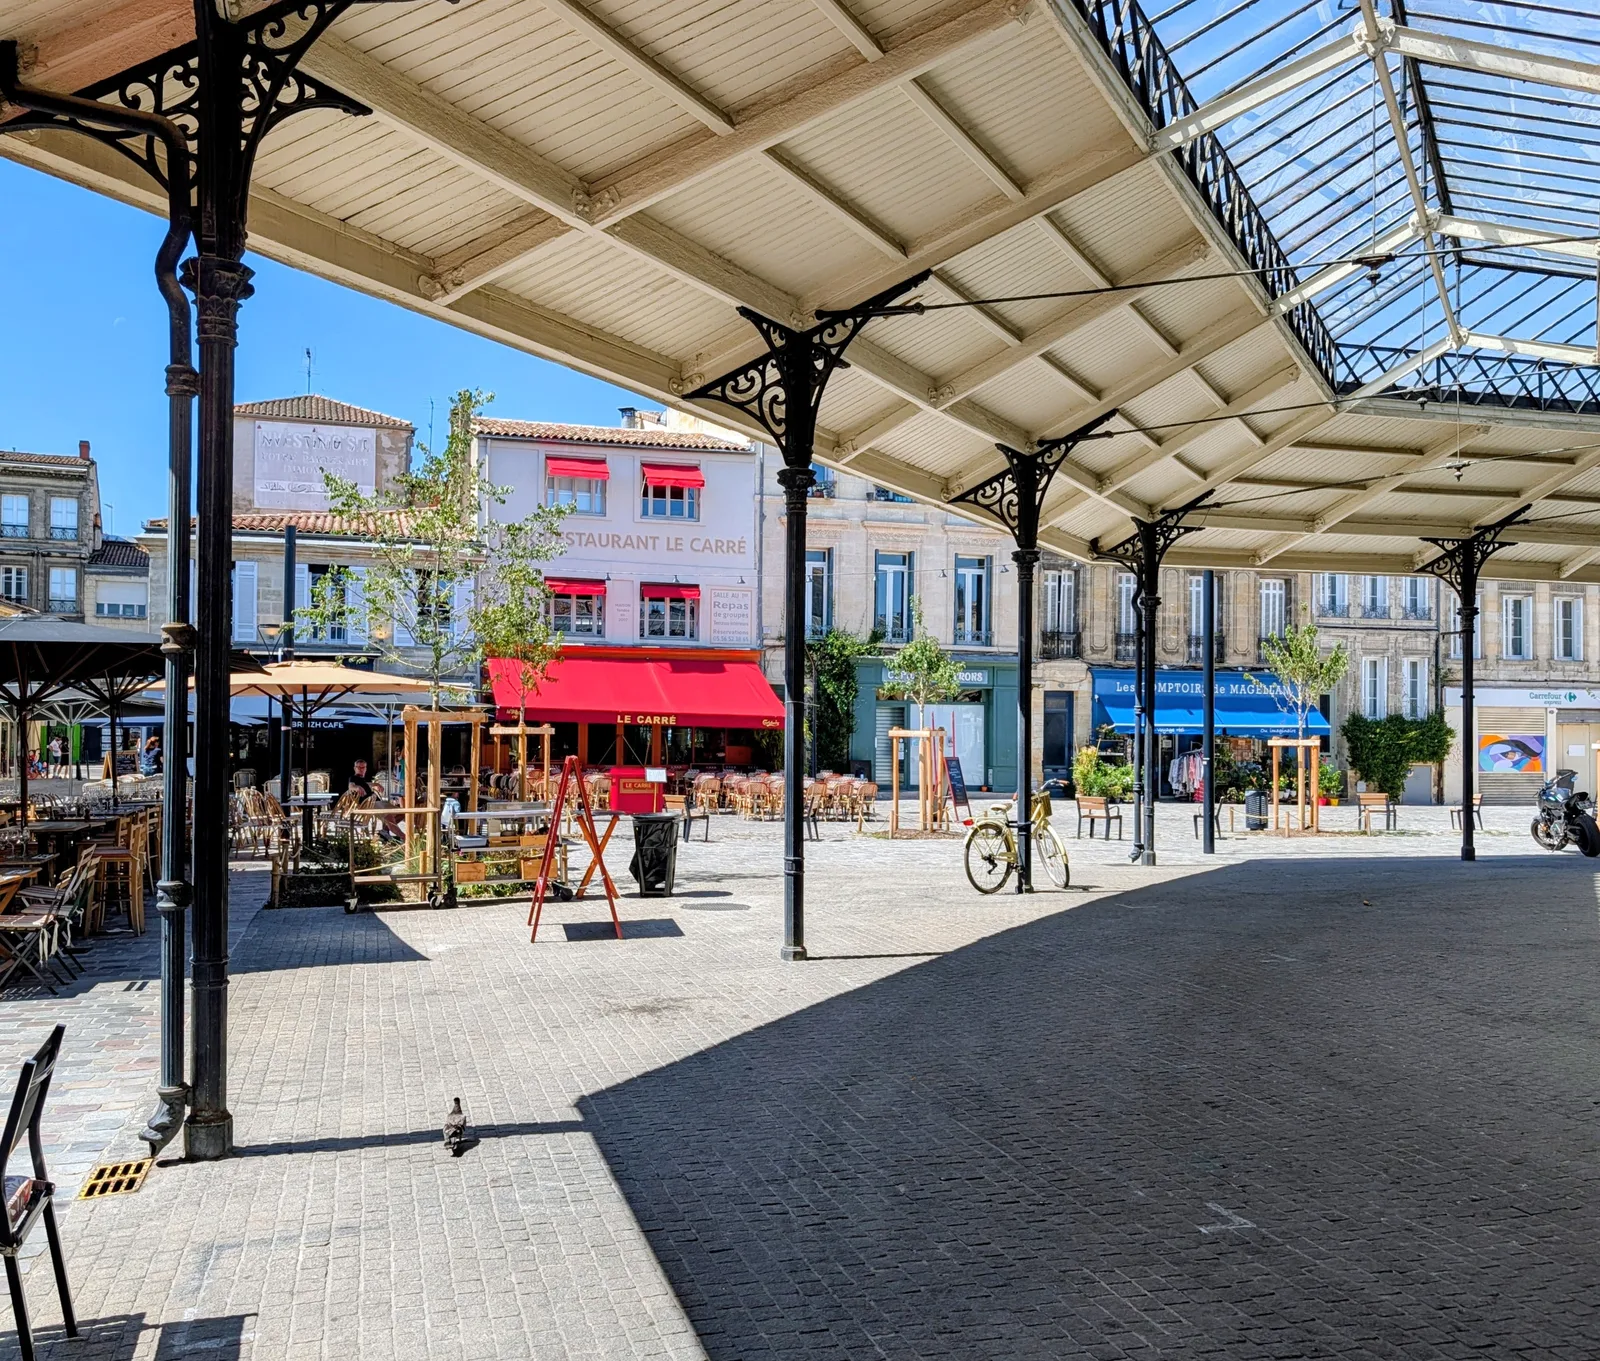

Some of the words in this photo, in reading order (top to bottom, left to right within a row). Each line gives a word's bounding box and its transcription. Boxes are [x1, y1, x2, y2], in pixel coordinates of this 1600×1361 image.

[666, 536, 684, 552] LE
[689, 536, 747, 555] CARRÉ
[713, 601, 749, 611] Repas
[1116, 681, 1136, 692] Les
[1141, 682, 1204, 694] MPTOIR
[1213, 683, 1226, 694] de
[1529, 692, 1562, 700] Carrefour
[616, 714, 632, 724] LE
[637, 714, 677, 725] CARRÉ
[291, 721, 322, 729] BRIZH
